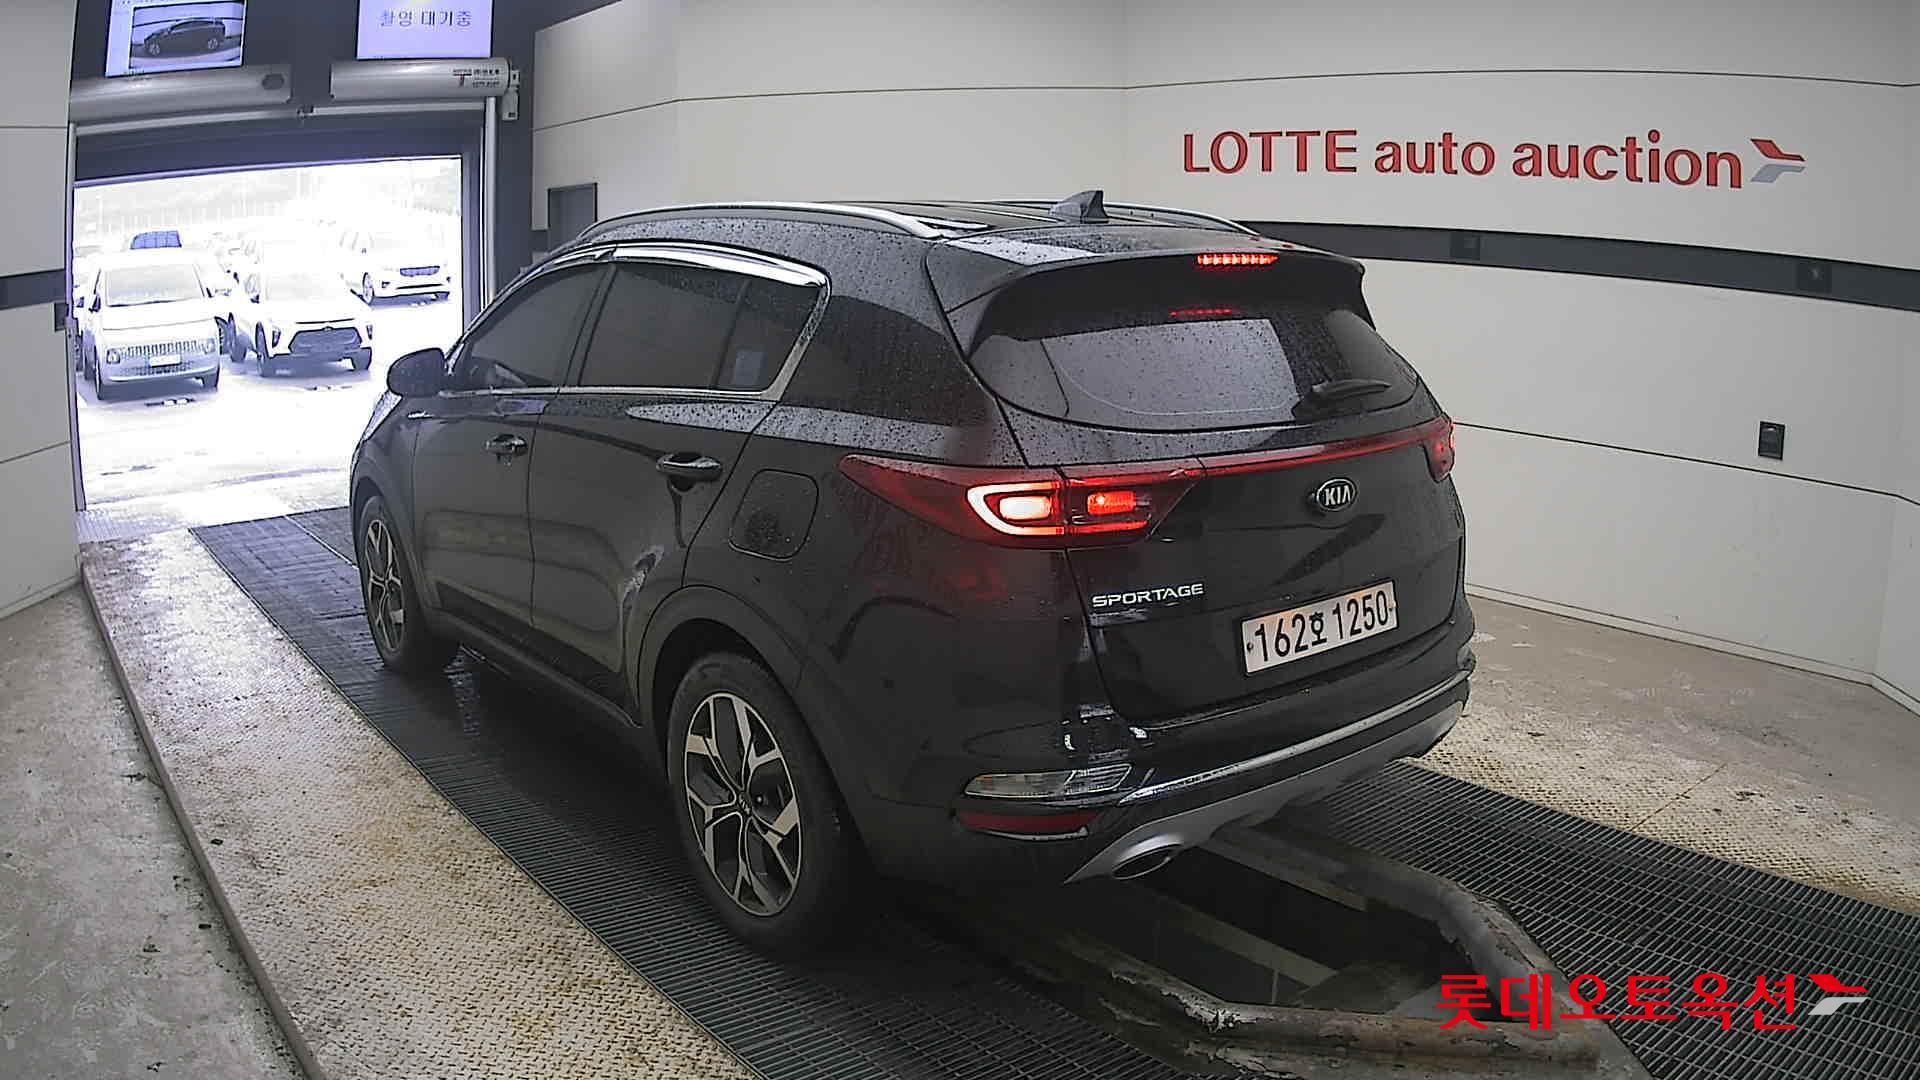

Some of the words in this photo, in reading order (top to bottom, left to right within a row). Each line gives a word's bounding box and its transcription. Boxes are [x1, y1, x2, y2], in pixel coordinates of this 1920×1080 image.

[420, 10, 471, 27] 대기중
[1183, 130, 1358, 174] LOTTE
[1374, 131, 1495, 176] auto
[1512, 129, 1743, 189] auction
[1324, 484, 1351, 506] KIA
[1092, 583, 1204, 608] SPORTAGE
